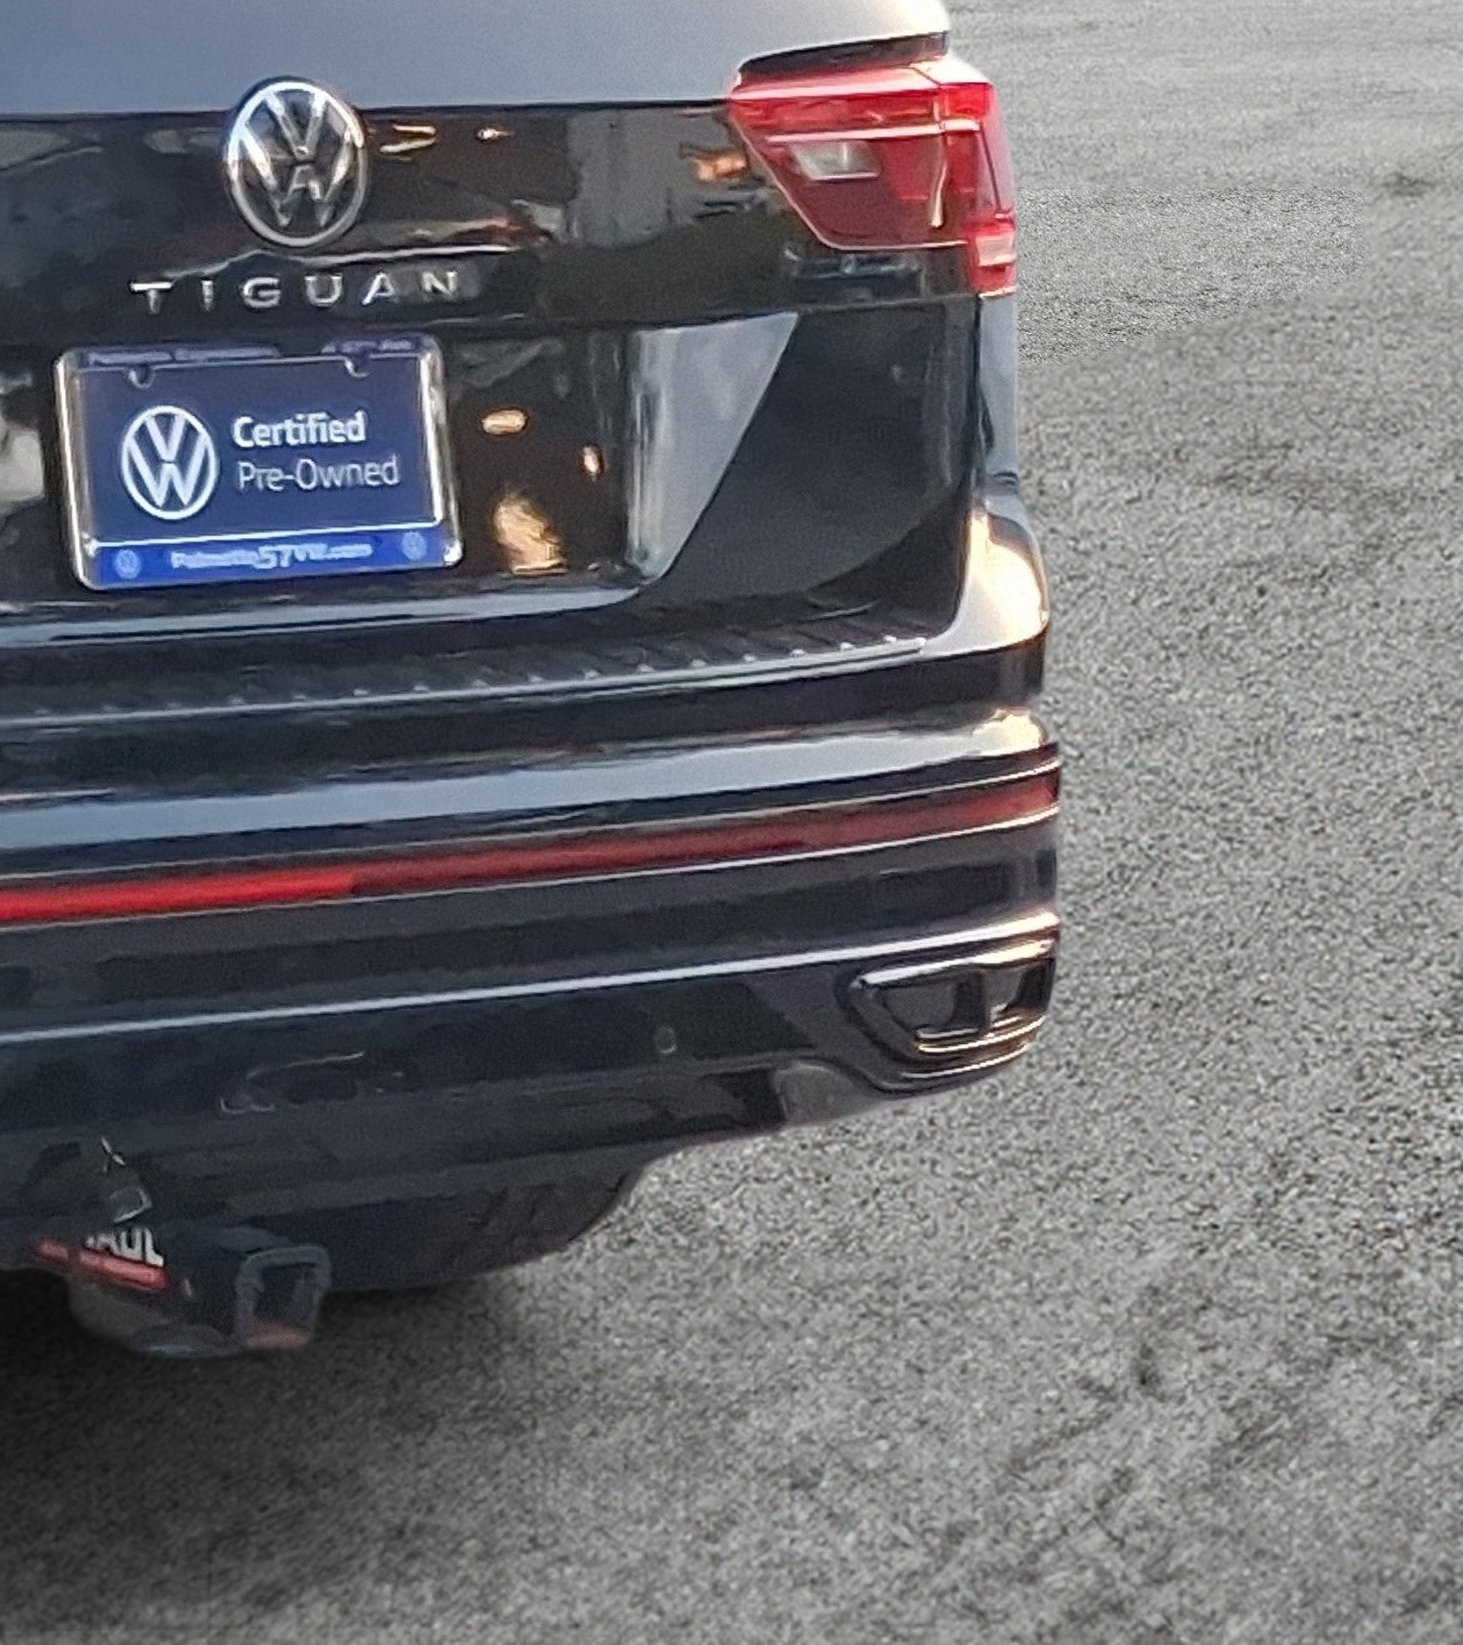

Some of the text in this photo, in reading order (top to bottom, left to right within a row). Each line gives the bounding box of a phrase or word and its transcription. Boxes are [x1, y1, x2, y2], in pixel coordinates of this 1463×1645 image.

[225, 78, 365, 245] VW
[129, 270, 458, 315] TIGUAN
[231, 409, 367, 449] Certified
[122, 406, 219, 519] VW
[236, 455, 401, 492] Pre-Owned
